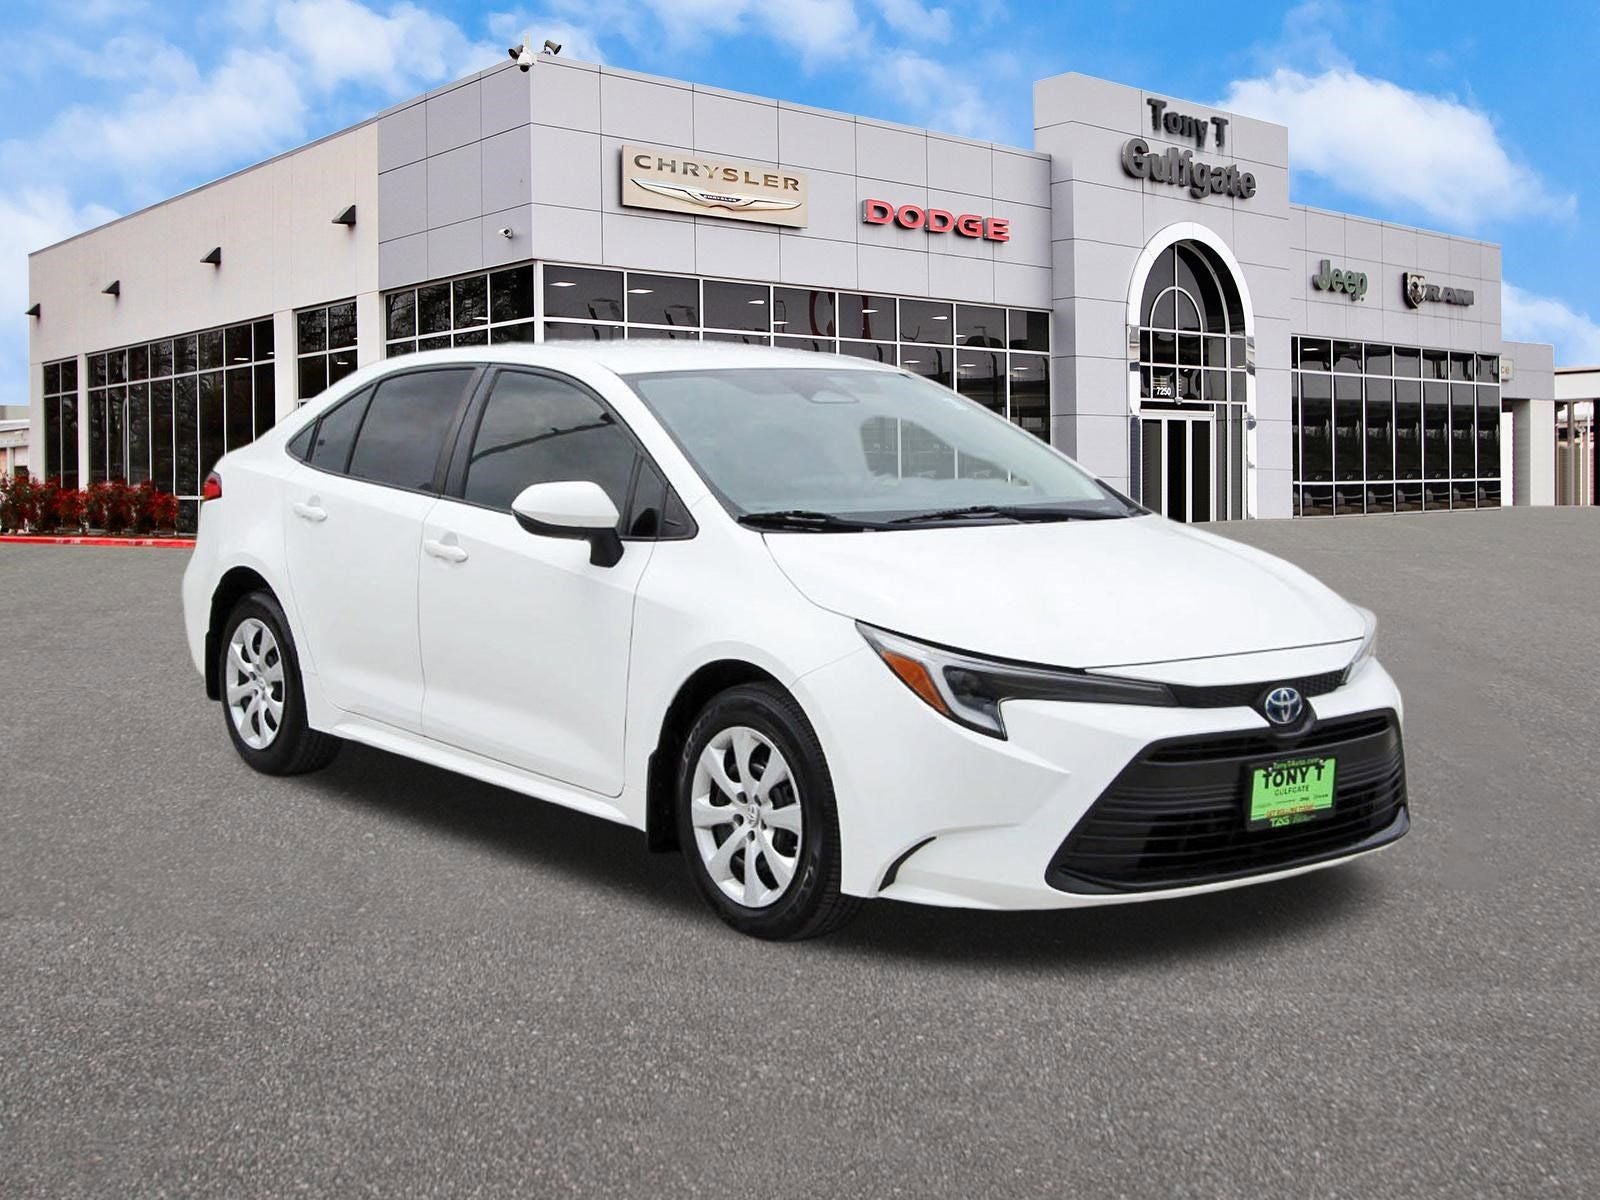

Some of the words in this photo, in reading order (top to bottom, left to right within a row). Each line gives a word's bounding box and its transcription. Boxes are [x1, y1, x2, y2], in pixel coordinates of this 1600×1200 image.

[1146, 98, 1209, 147] Tony
[1210, 116, 1229, 147] T
[633, 154, 800, 191] CHRYSLER
[1122, 138, 1257, 199] Gulfgate
[862, 199, 1011, 243] DODGE
[1312, 259, 1368, 301] Jeep
[1425, 284, 1475, 306] RAM
[1156, 386, 1172, 396] 7250
[1262, 767, 1310, 789] TONY
[1314, 763, 1325, 781] T
